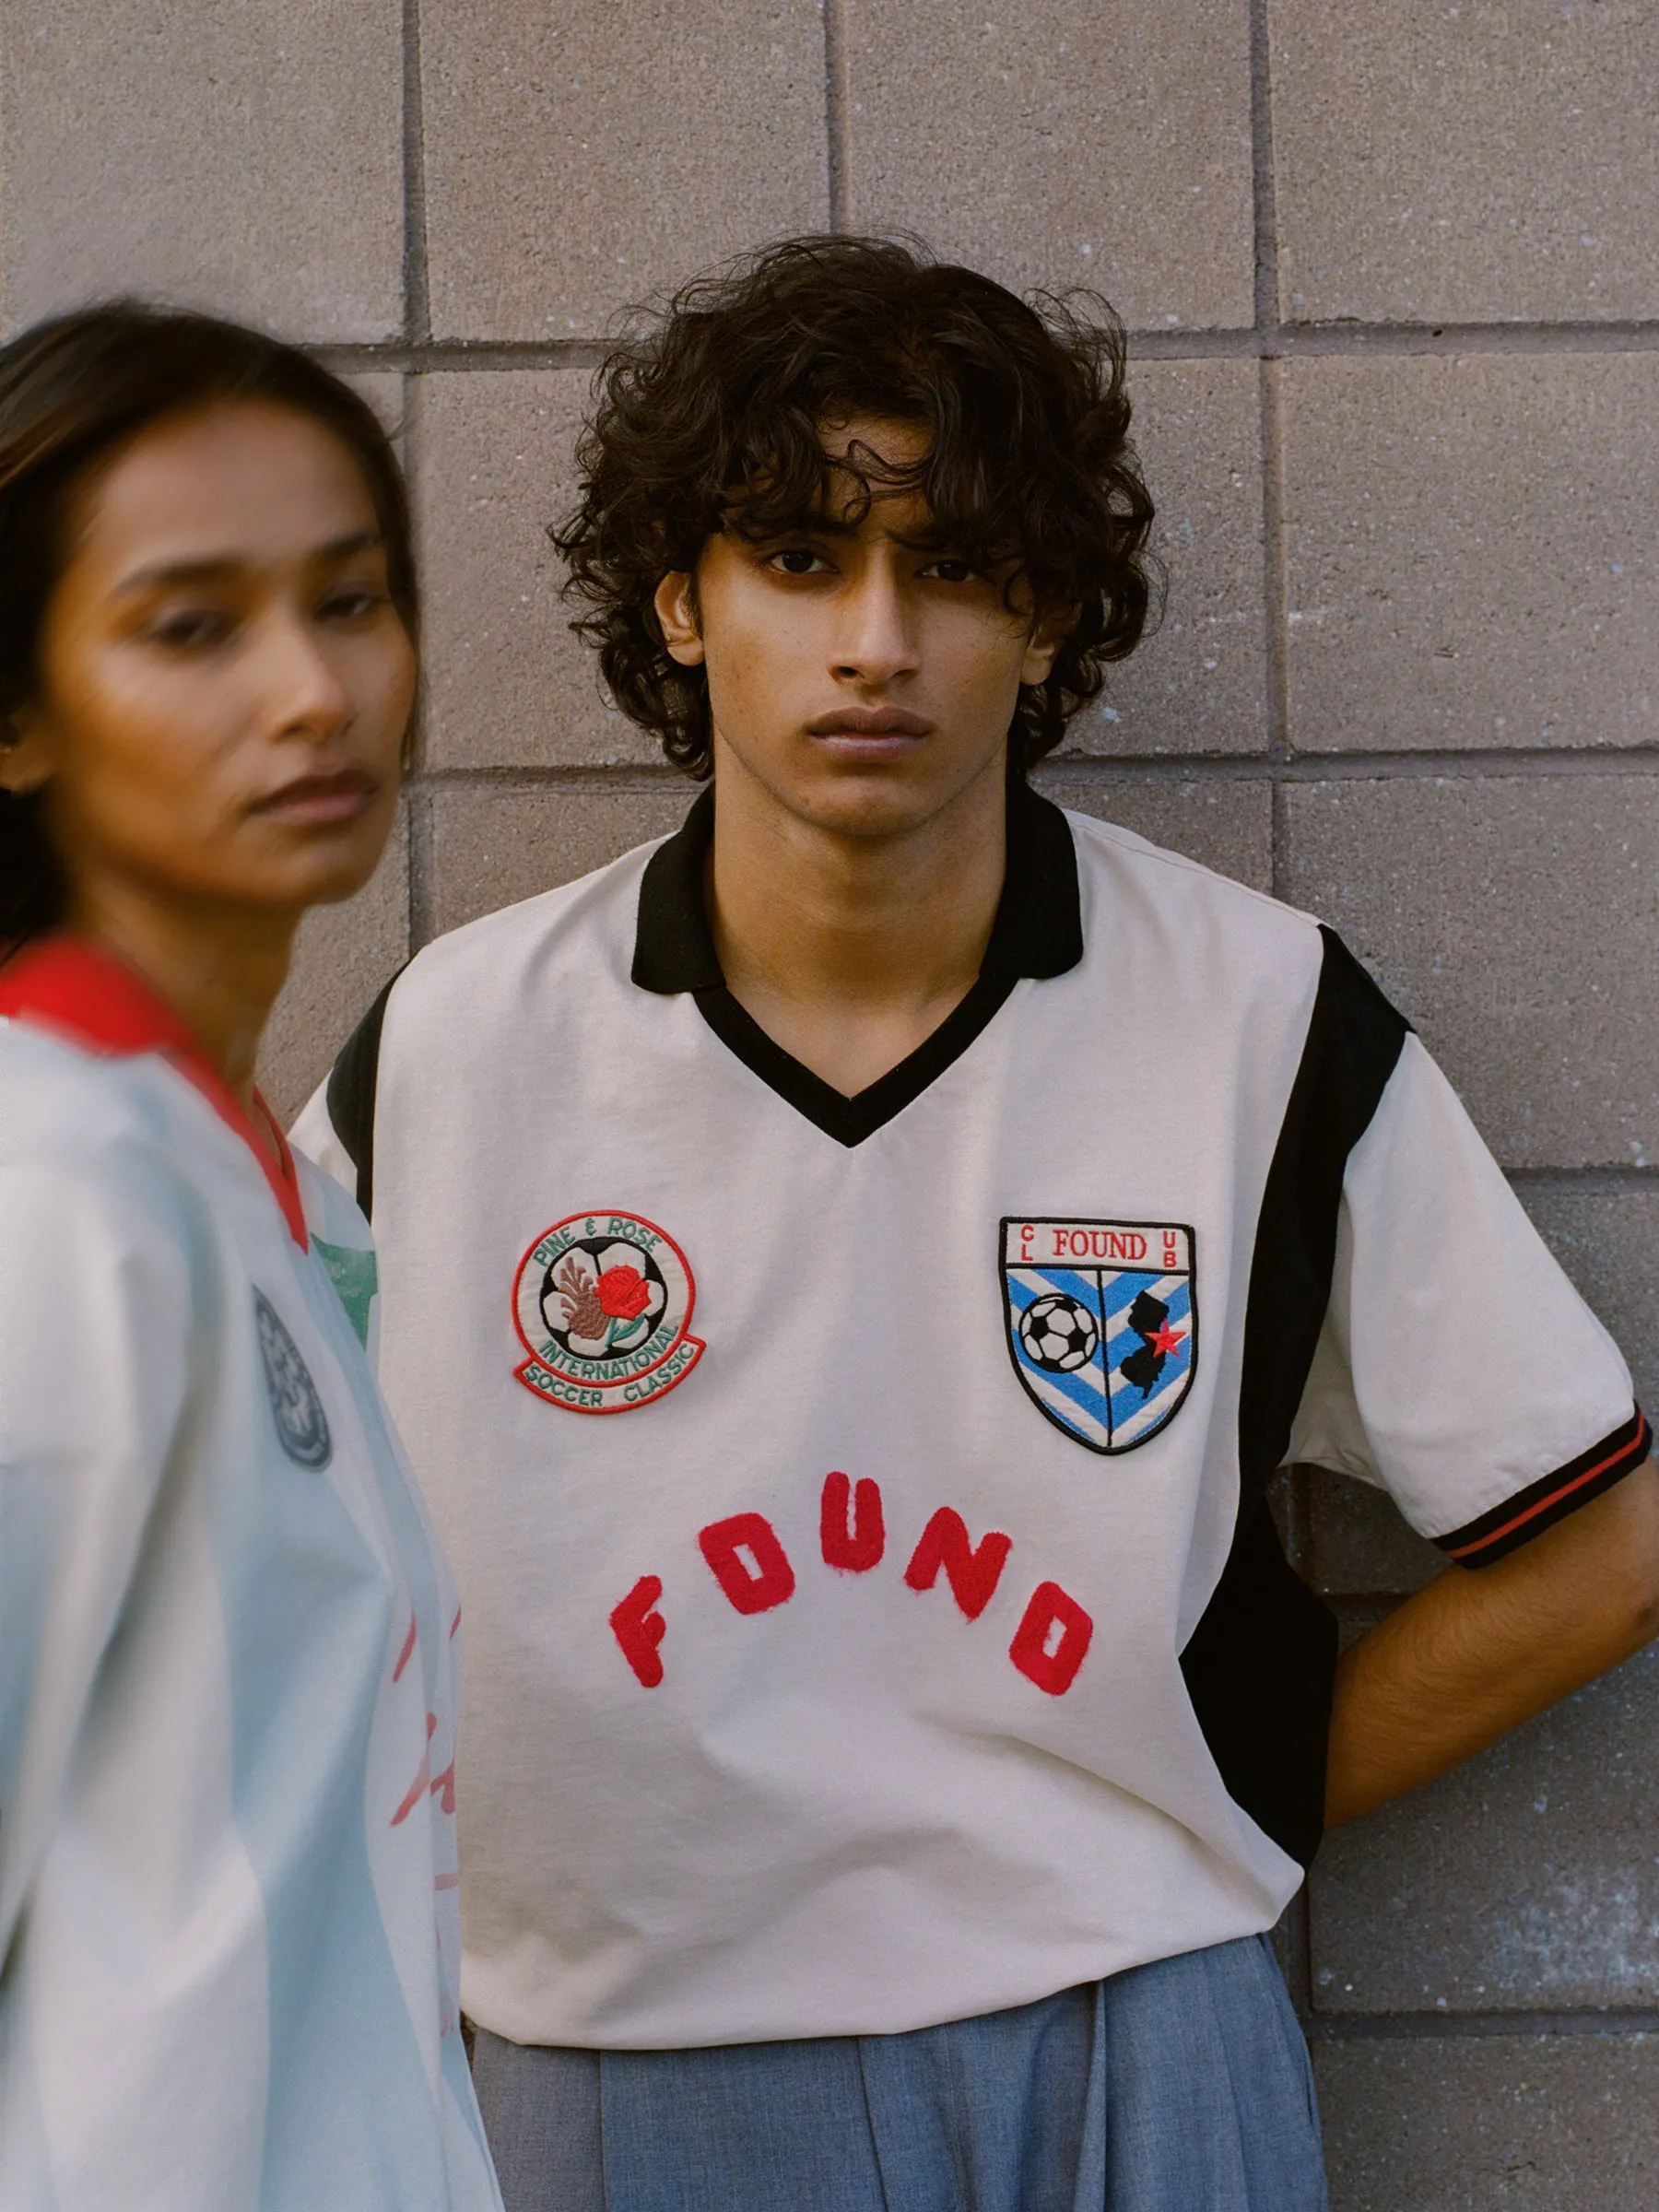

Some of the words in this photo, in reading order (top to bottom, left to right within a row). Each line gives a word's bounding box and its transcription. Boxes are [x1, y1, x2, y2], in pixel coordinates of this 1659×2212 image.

[533, 1227, 575, 1266] PINE
[608, 1217, 663, 1253] ROSE
[1052, 1229, 1147, 1260] FOUND
[525, 1366, 603, 1406] SOCCER
[623, 1345, 694, 1402] CLASSIC
[537, 1325, 678, 1381] INTERNATIONAL
[609, 1471, 1093, 1696] FOUND
